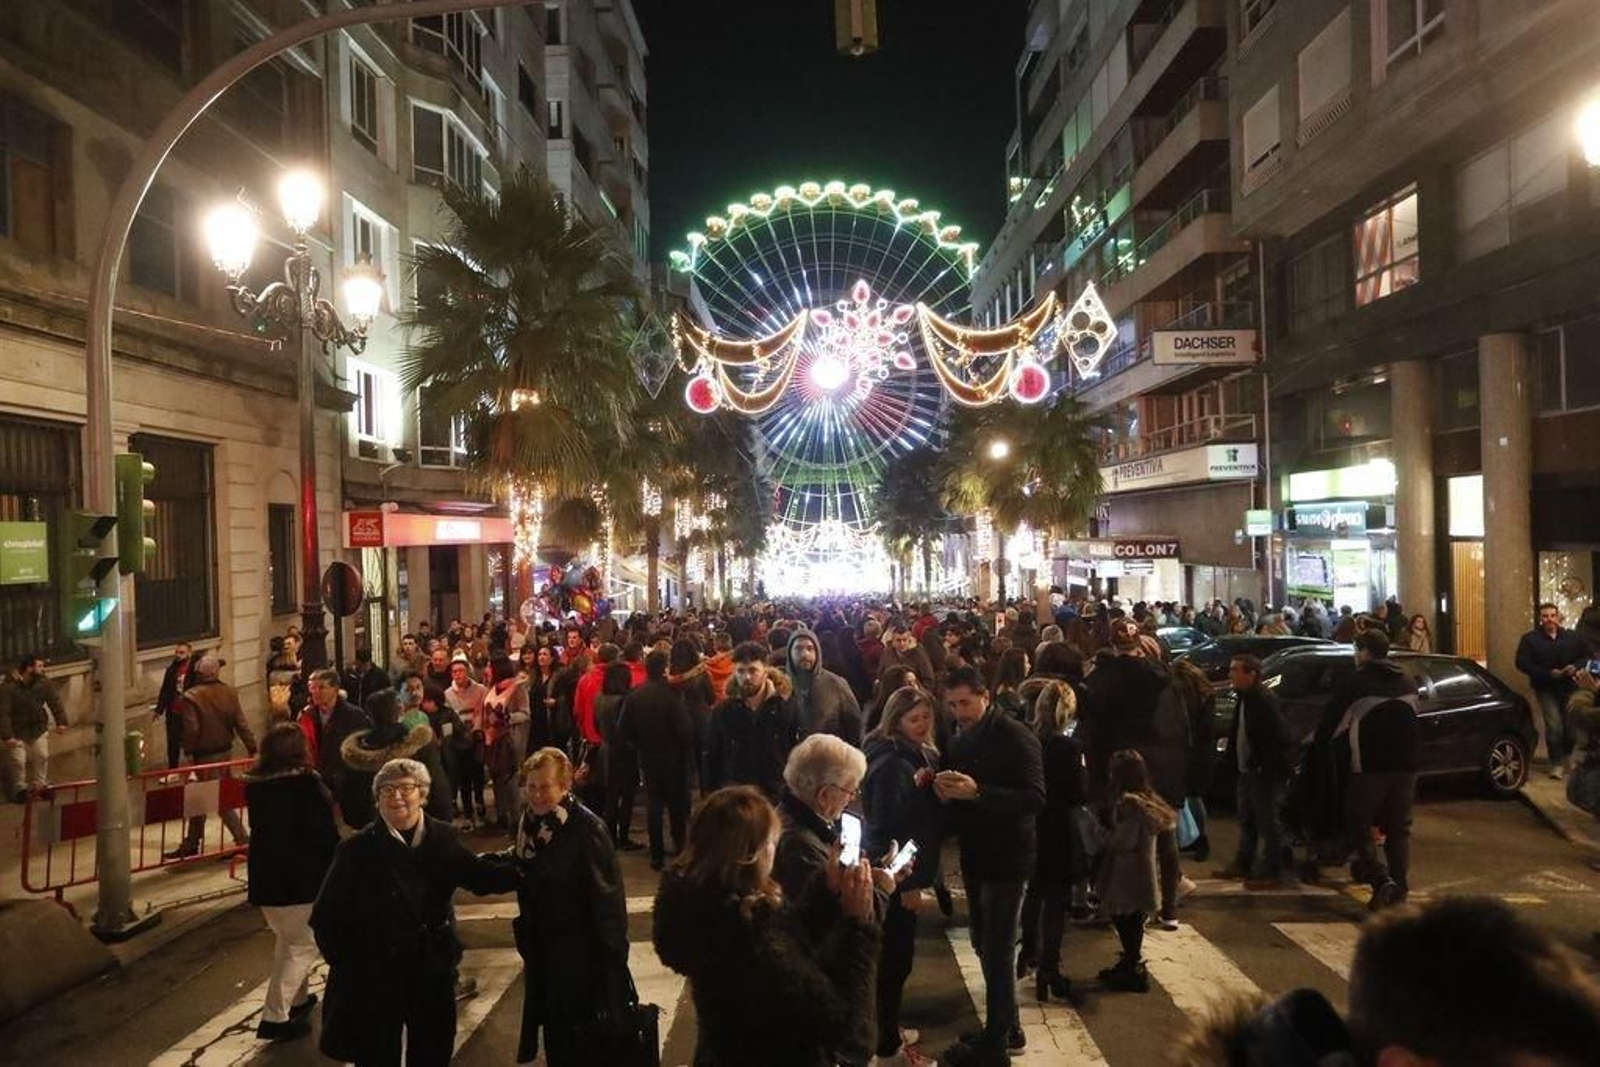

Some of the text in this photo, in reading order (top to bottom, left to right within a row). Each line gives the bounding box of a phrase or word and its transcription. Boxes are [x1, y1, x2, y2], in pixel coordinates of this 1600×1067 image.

[1174, 336, 1236, 350] DACHSER
[1118, 459, 1163, 479] PREVENTIVA
[1210, 464, 1257, 472] PREVENTIVA
